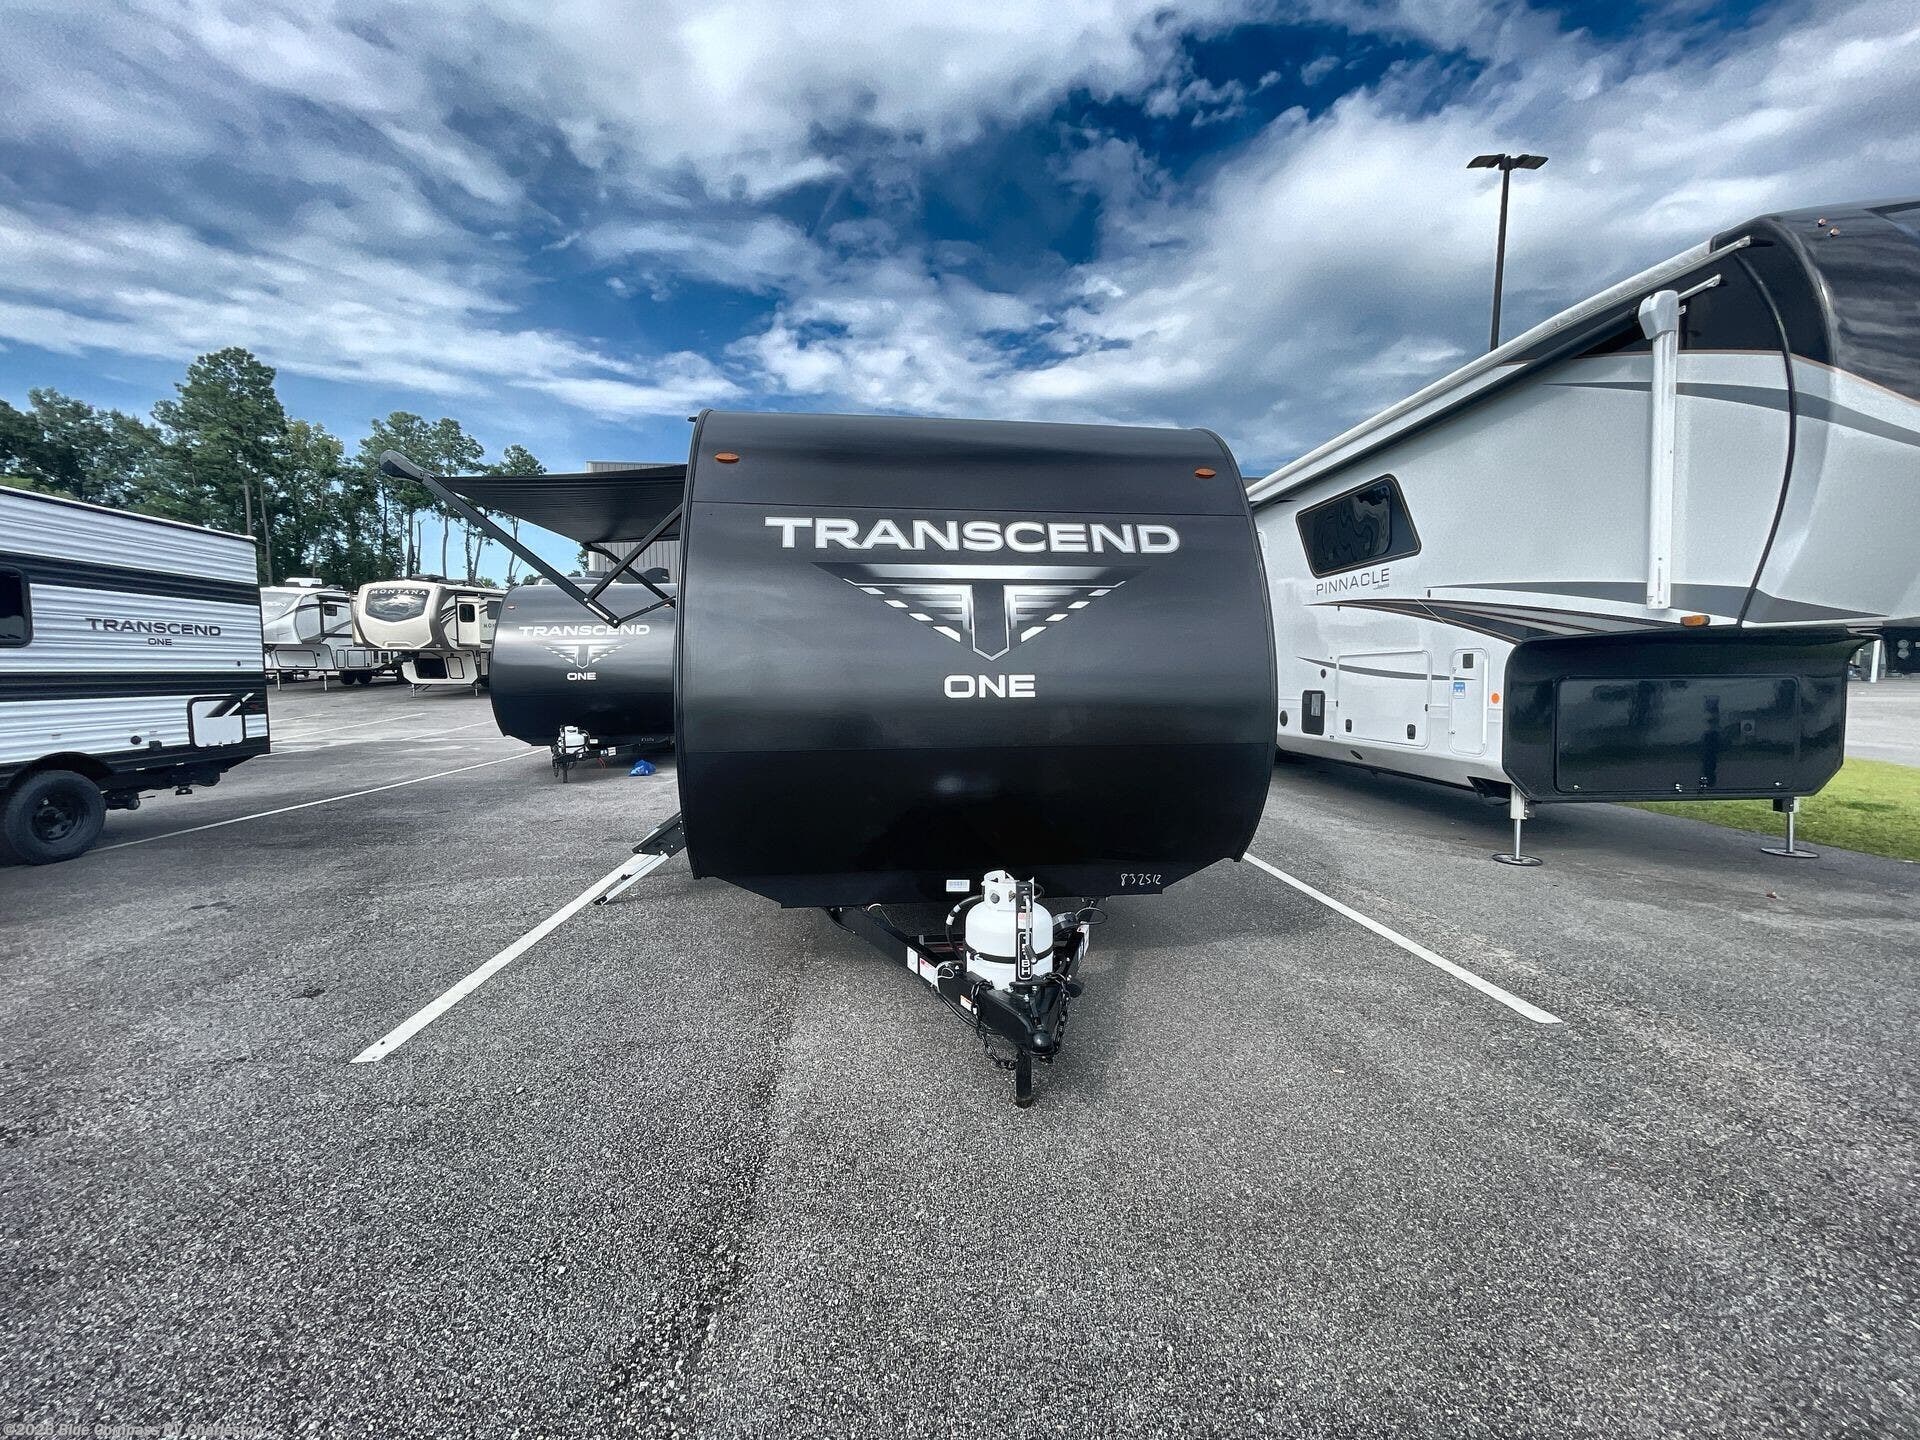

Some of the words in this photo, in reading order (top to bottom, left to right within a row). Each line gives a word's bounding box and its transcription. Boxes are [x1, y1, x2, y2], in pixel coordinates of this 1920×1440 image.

[764, 516, 1181, 554] TRANSCEND
[1316, 567, 1390, 595] PINNACLE
[370, 588, 427, 596] MONTANA
[85, 617, 222, 637] TRANSCEND
[518, 624, 651, 637] TRANSCEND
[147, 637, 173, 646] ONE
[566, 672, 597, 681] ONE
[943, 673, 1037, 699] ONE
